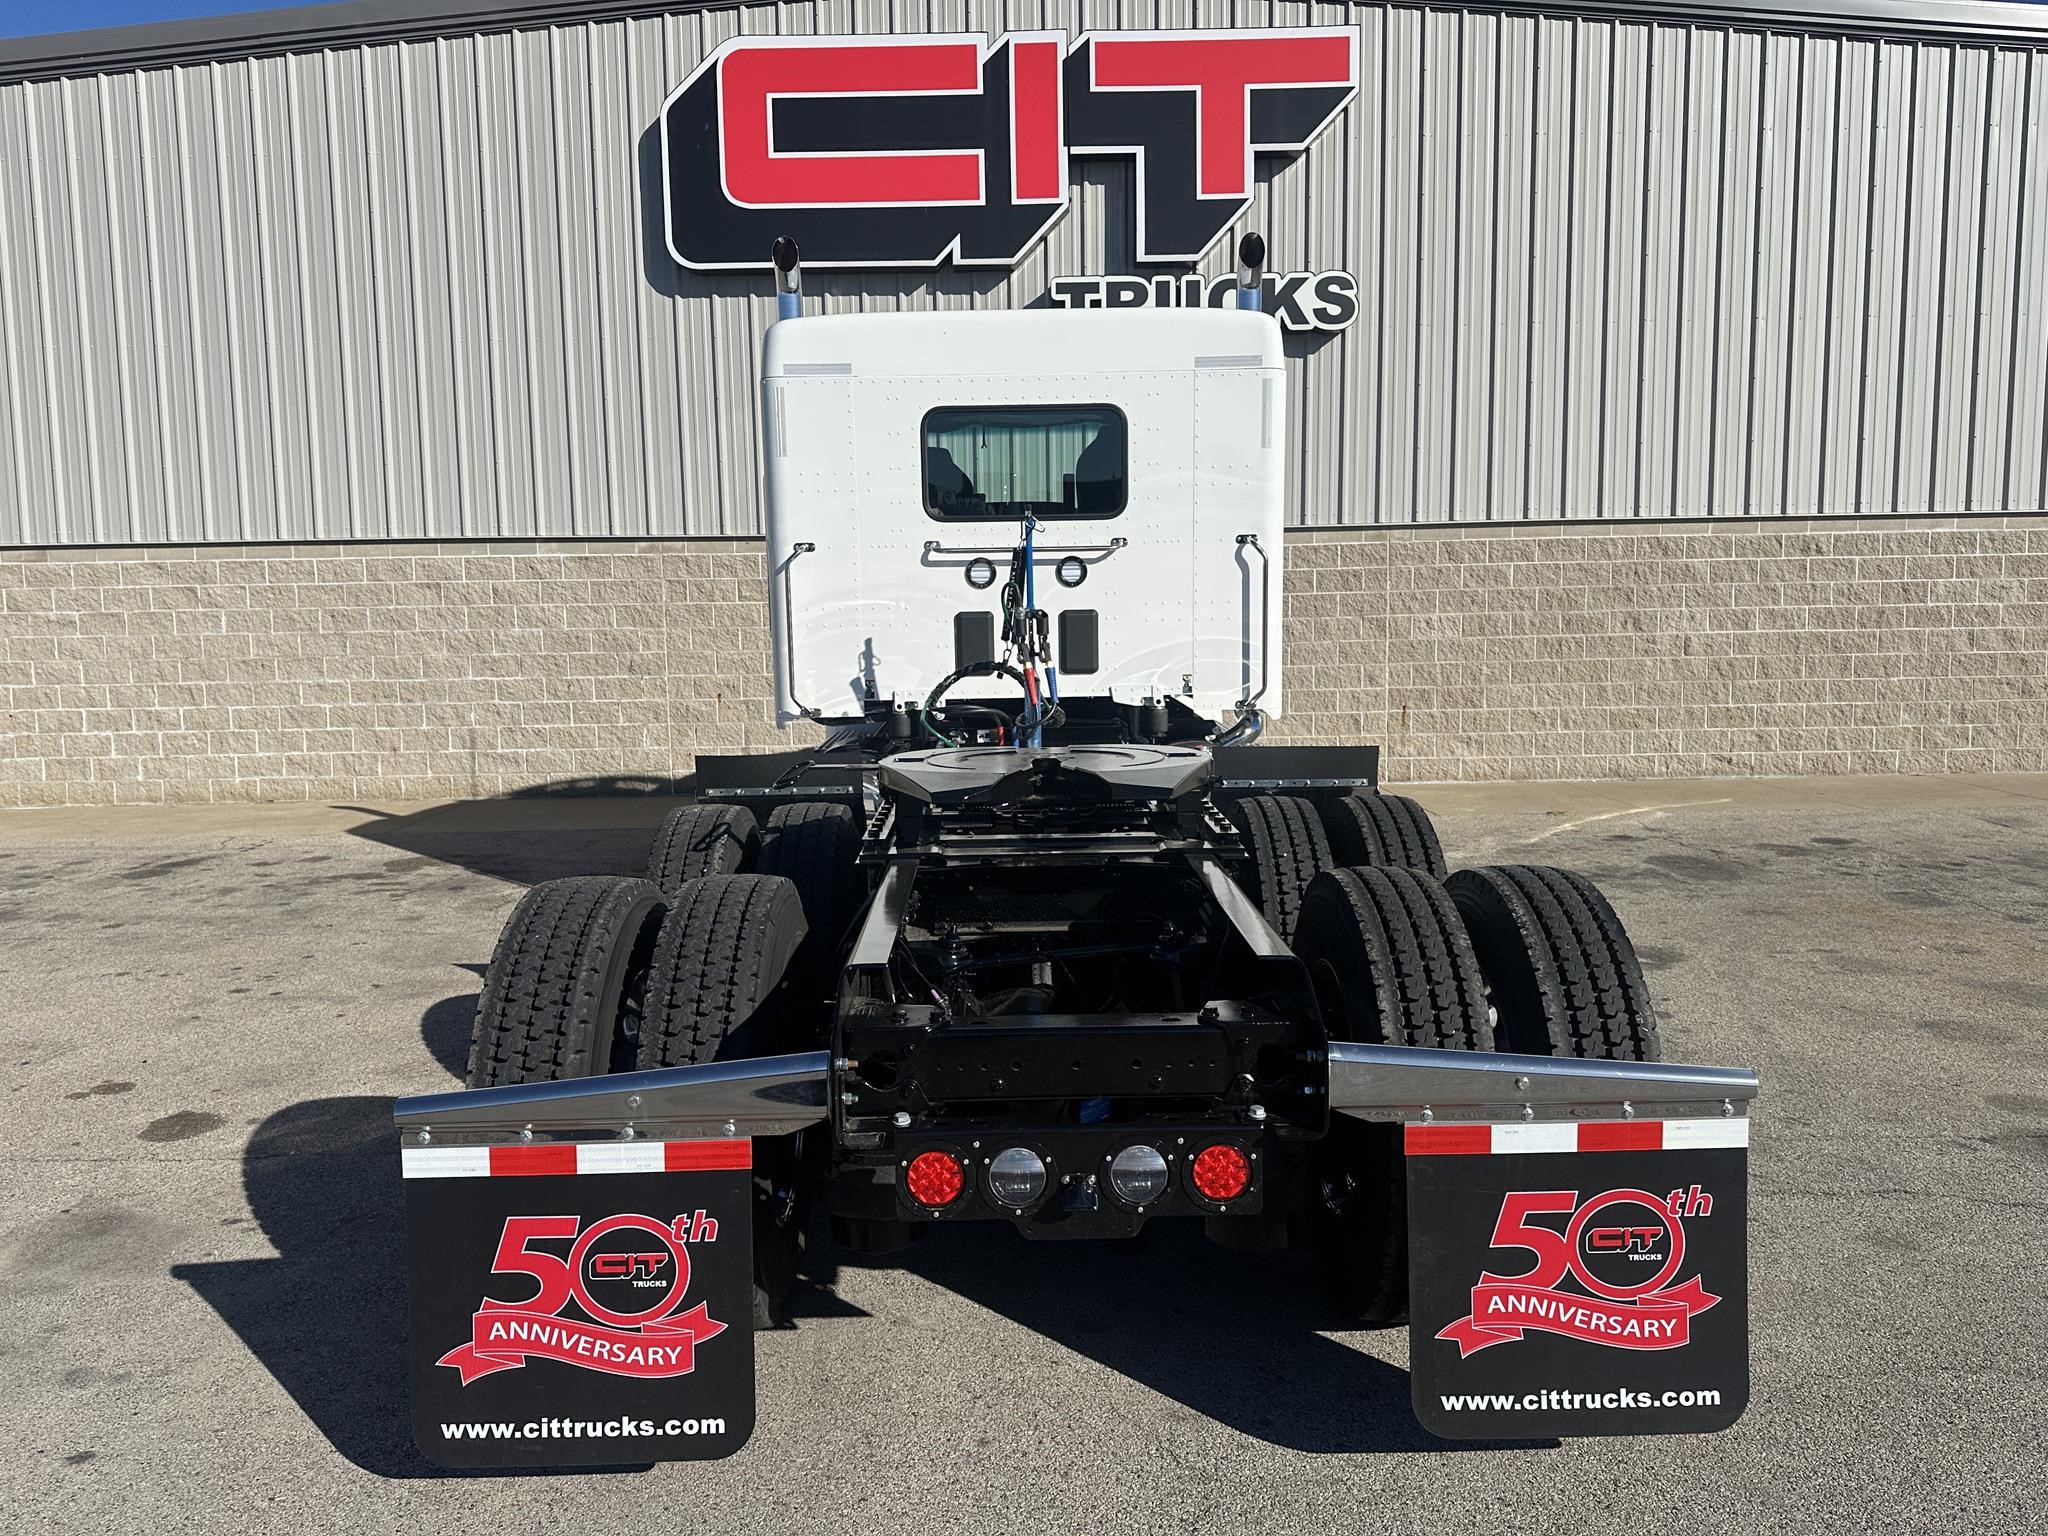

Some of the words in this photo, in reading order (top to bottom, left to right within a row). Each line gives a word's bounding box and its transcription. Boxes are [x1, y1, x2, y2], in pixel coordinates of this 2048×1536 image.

[664, 27, 1360, 269] CIT
[1478, 1185, 1713, 1300] 50th
[1586, 1226, 1664, 1254] CIT
[478, 1209, 719, 1328] 50th
[589, 1252, 669, 1280] CIT
[632, 1280, 667, 1288] TRUCKS
[1487, 1294, 1678, 1339] ANNIVERSARY
[488, 1321, 683, 1366] ANNIVERSARY
[1440, 1387, 1721, 1411] www.cittrucks.com
[440, 1416, 726, 1440] www.cittrucks.com
